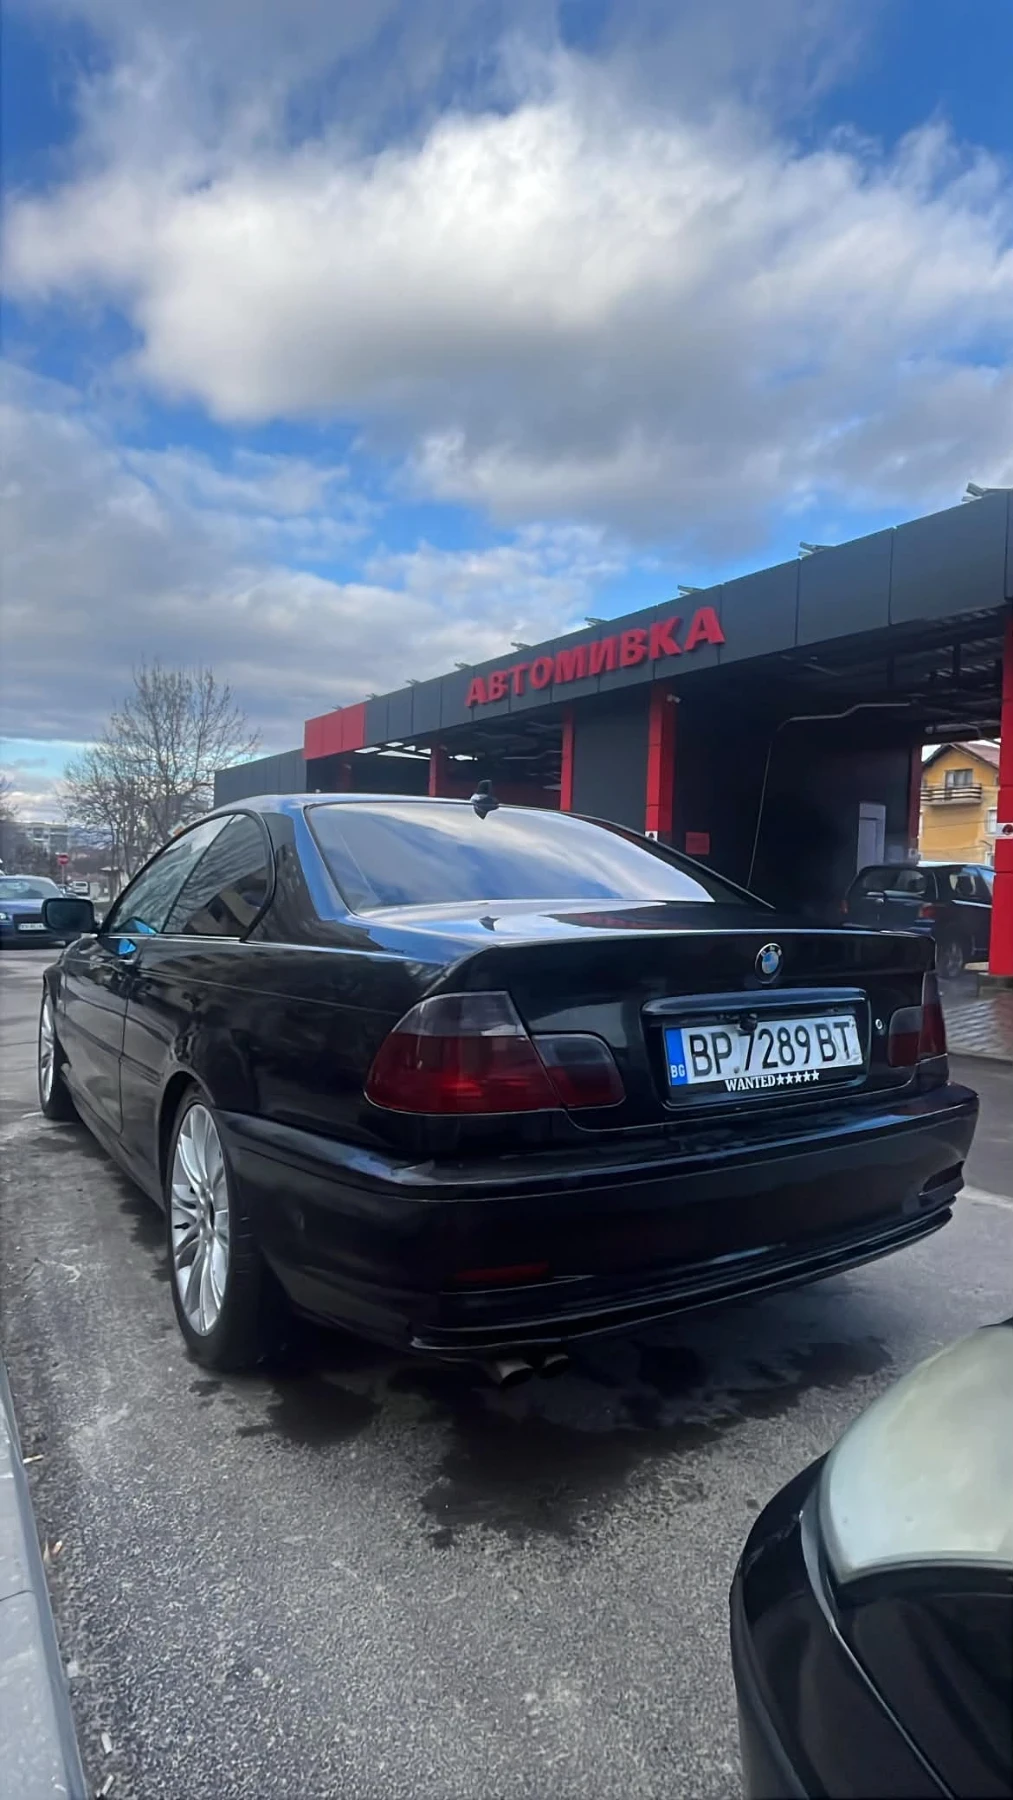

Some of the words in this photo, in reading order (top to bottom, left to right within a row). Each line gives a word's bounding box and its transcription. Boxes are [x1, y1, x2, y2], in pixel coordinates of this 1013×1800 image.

[465, 606, 726, 707] АВТОМИВКА
[670, 1064, 686, 1078] BG
[725, 1074, 776, 1092] WANTED
